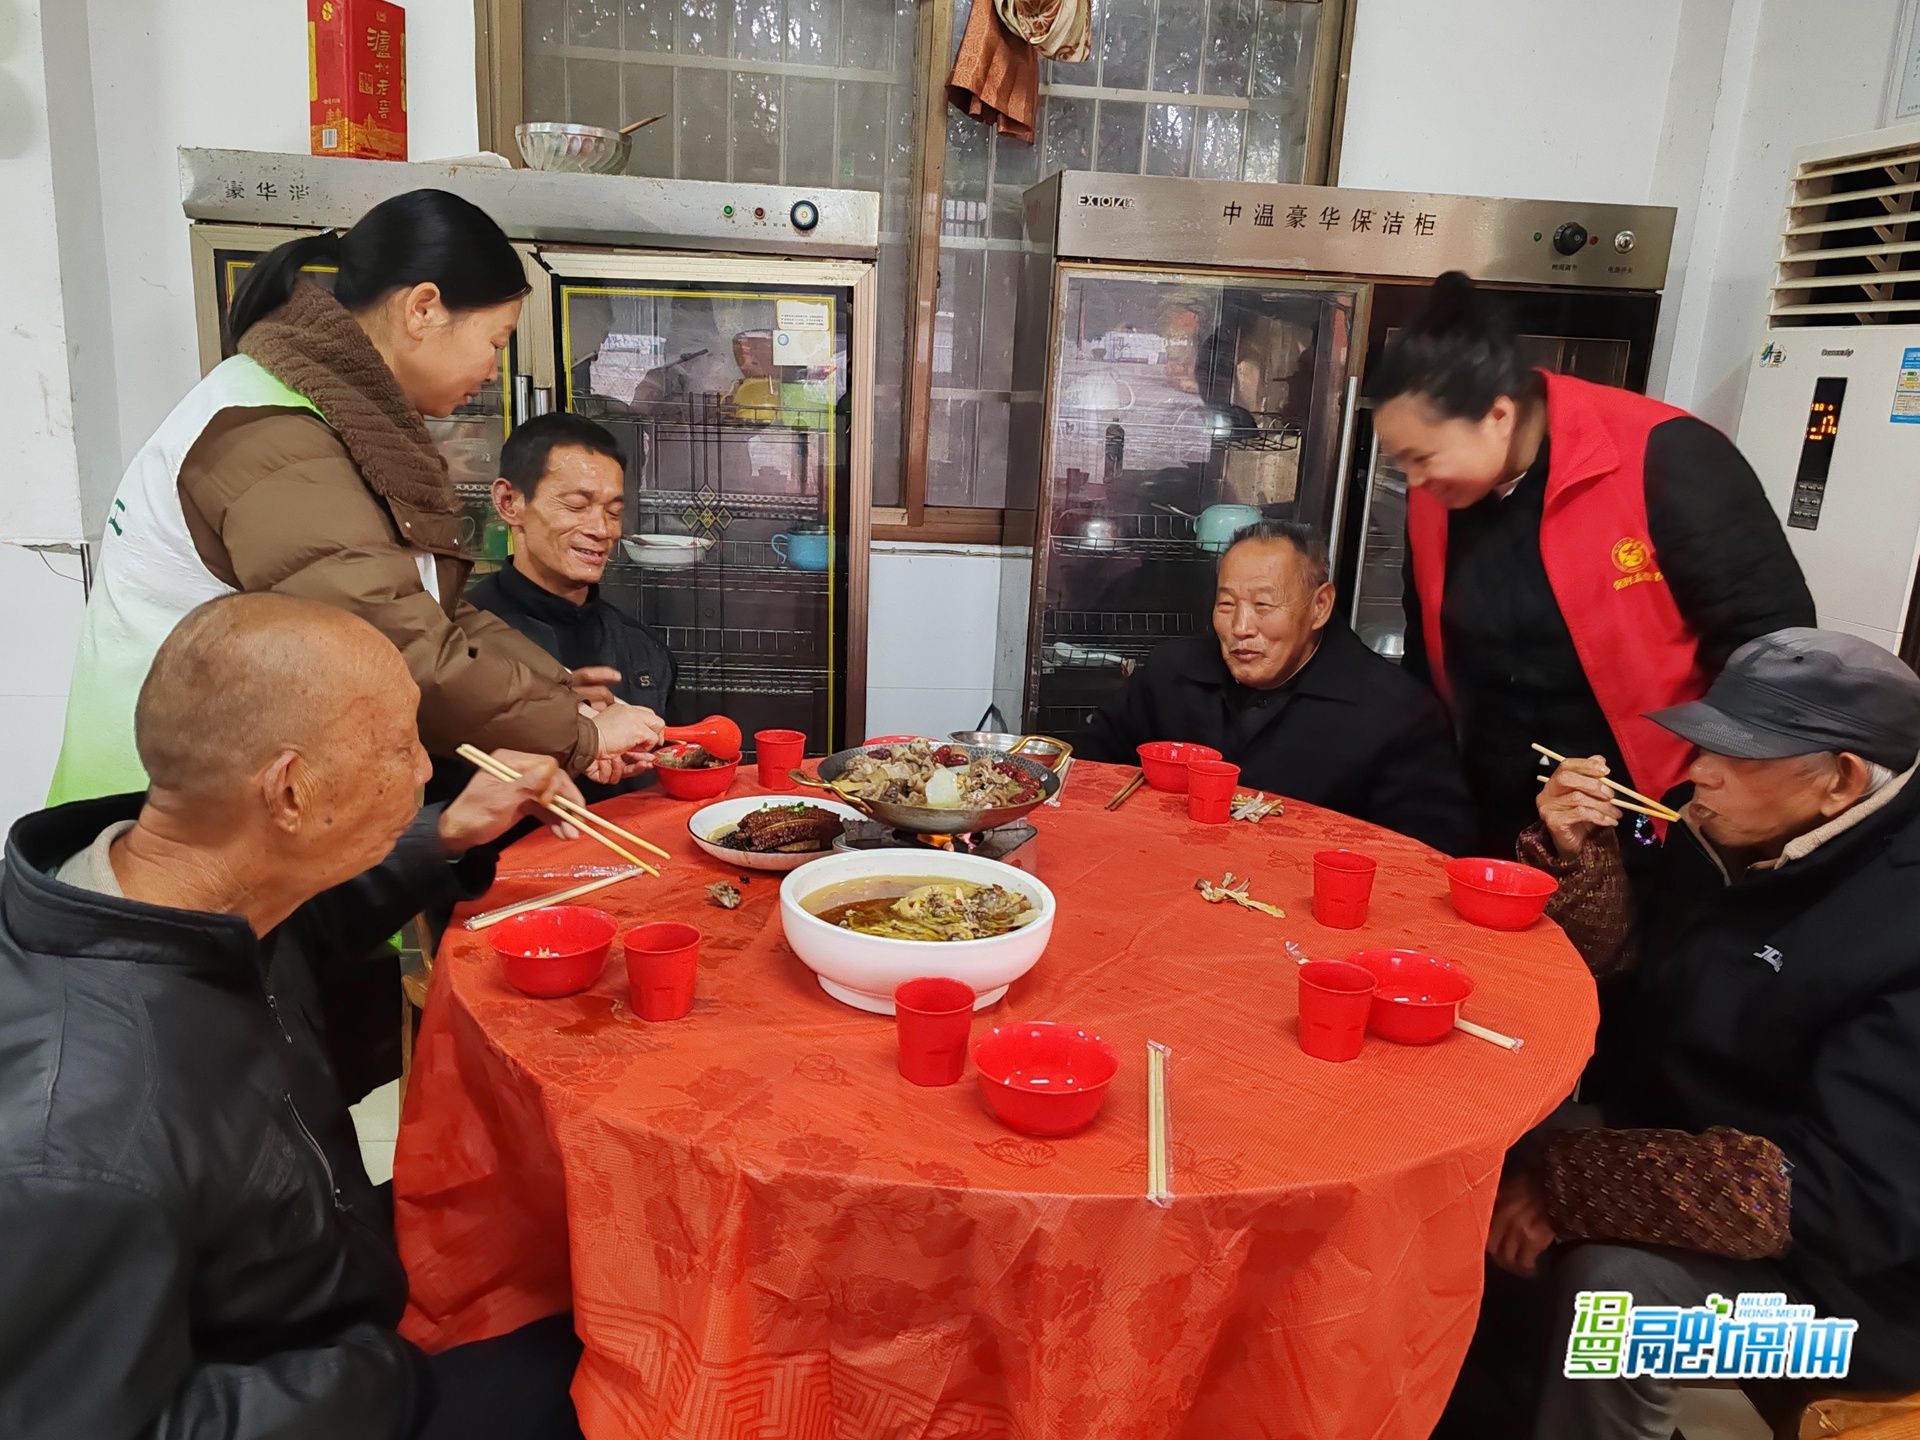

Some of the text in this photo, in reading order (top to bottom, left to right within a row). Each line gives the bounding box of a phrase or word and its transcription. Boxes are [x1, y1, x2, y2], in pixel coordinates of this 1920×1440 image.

[1222, 200, 1437, 236] 中温豪华保洁柜
